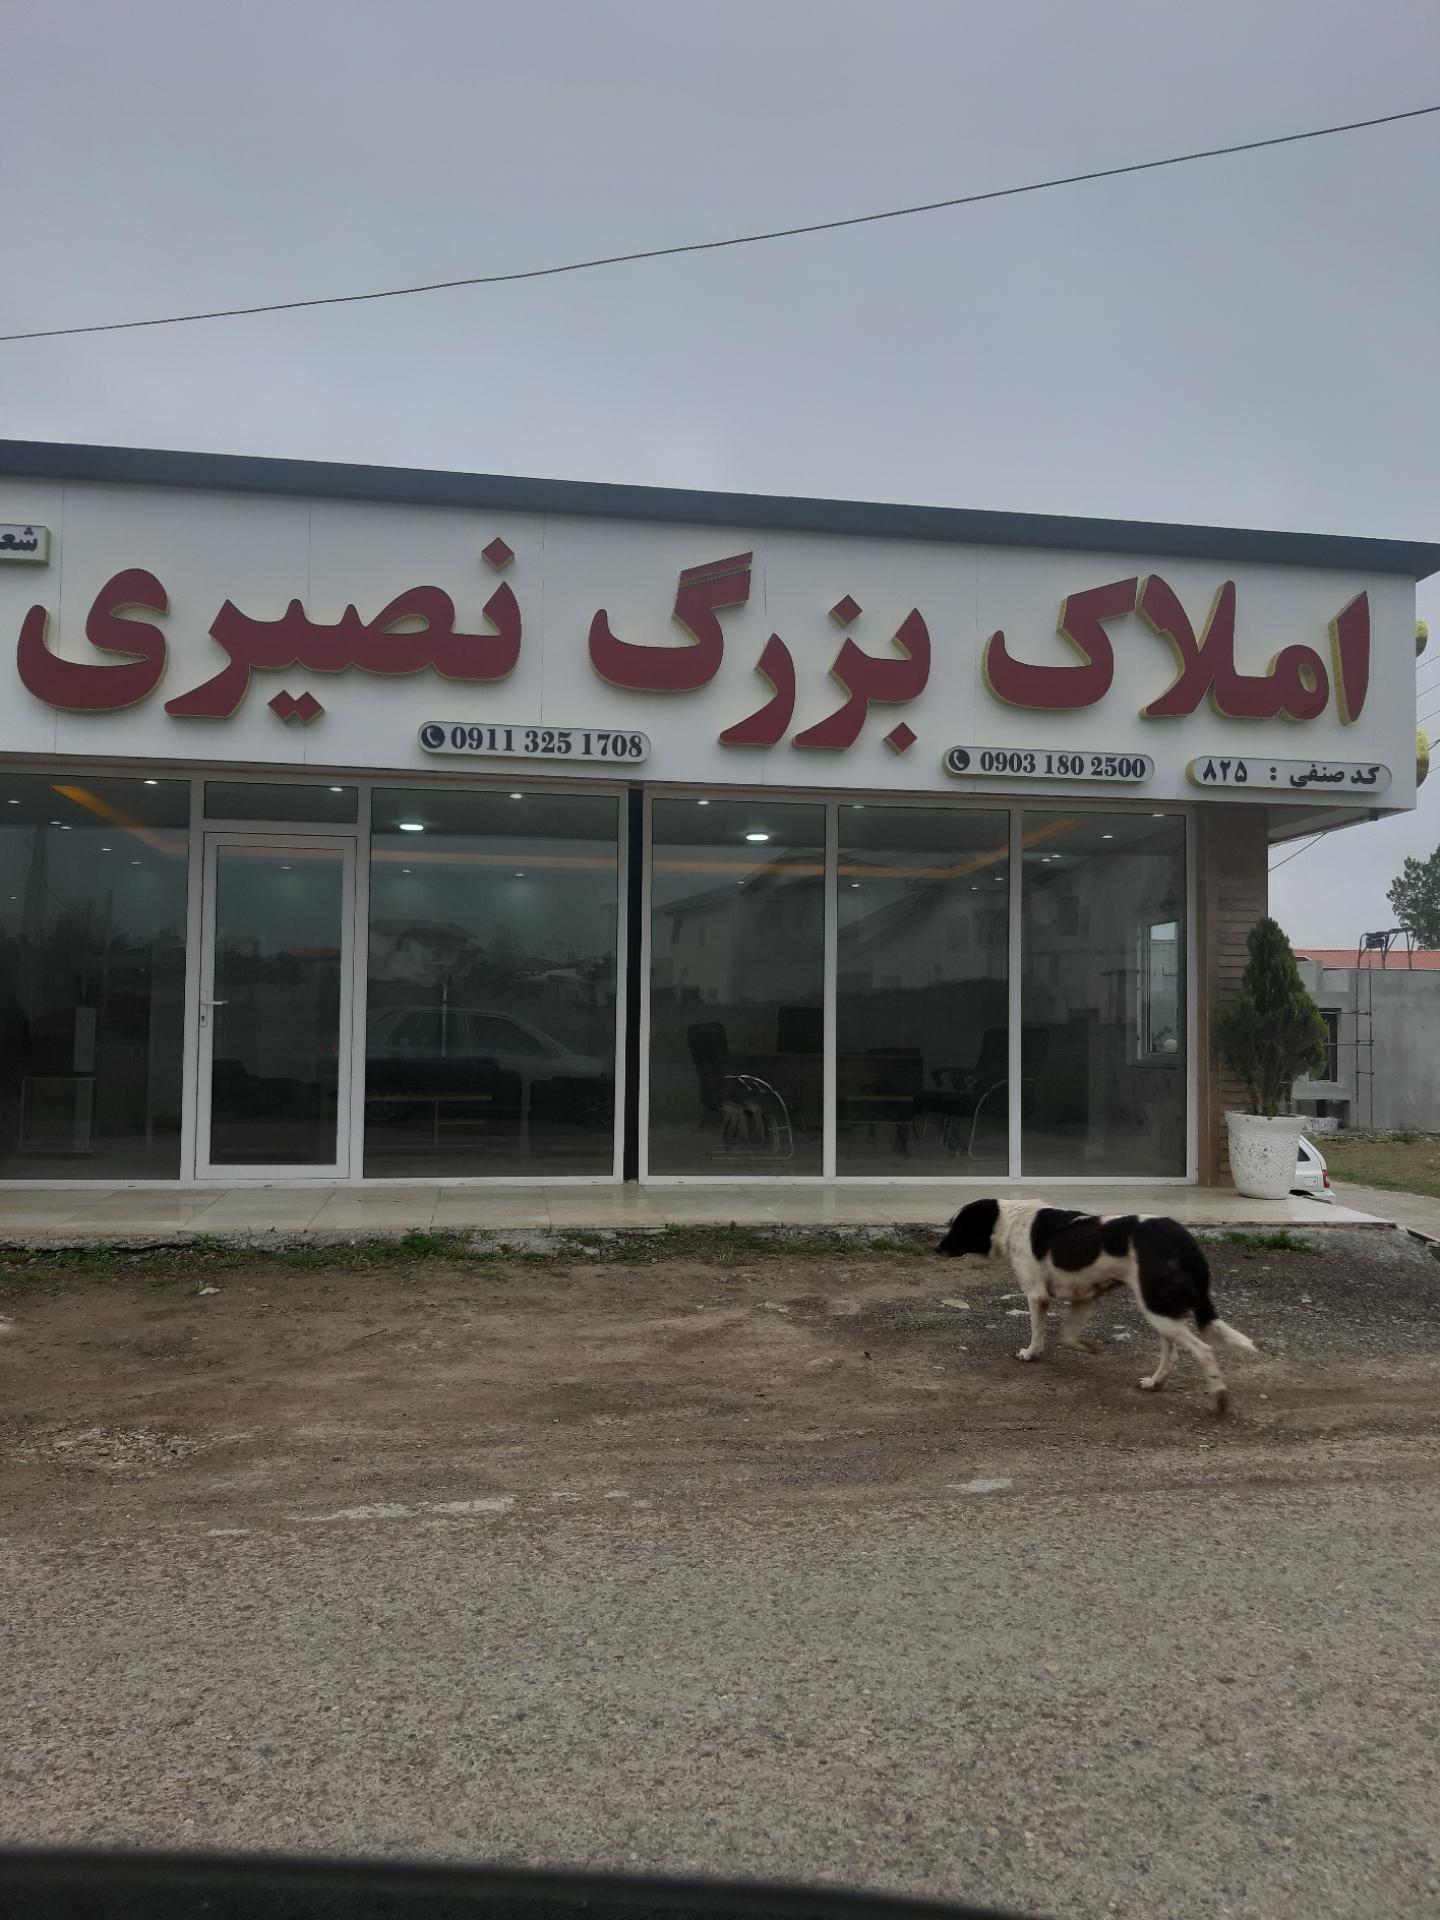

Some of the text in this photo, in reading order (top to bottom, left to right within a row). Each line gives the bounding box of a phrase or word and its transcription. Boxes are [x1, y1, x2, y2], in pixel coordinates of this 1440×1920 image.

[16, 537, 1370, 754] املاک بزرگ نصیری
[451, 726, 643, 757] 0911 325 1708
[980, 751, 1146, 778] 0903 180 2500
[1202, 759, 1248, 782] ۸۲۵
[1289, 763, 1345, 787] صنفی
[1350, 766, 1379, 784] کد
